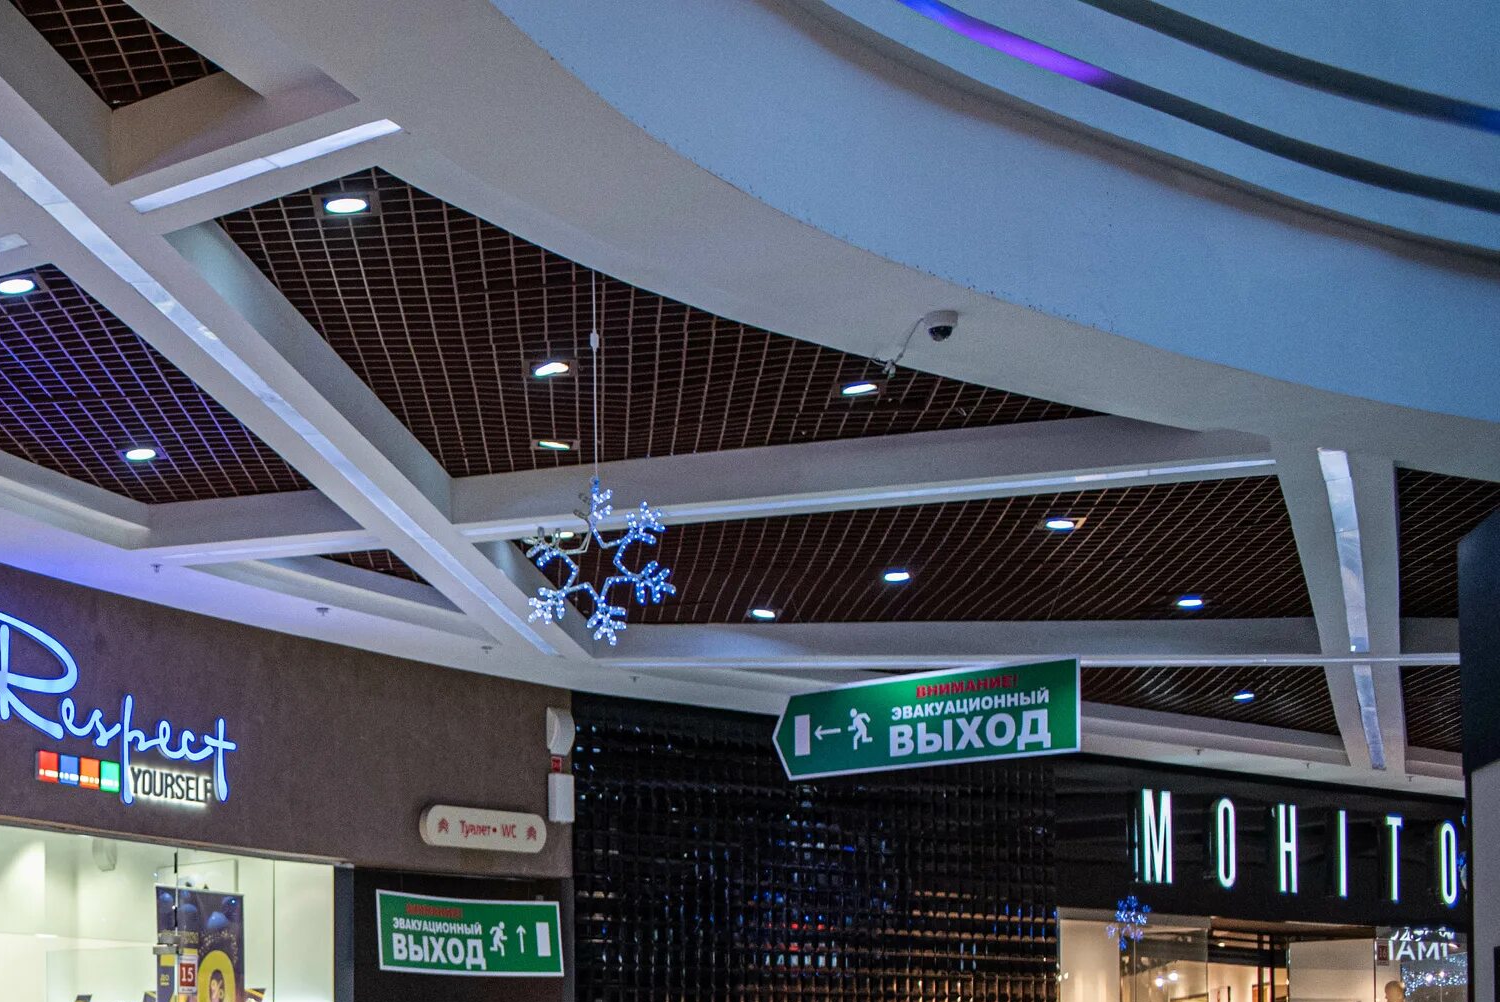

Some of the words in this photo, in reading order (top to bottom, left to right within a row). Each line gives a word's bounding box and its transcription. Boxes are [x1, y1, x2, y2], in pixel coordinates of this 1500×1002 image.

[916, 674, 1019, 699] ВНИМАНИЕ!
[891, 687, 1050, 720] ЭВАКУАЦИОННЫЙ
[889, 708, 1051, 757] ВЫХОД
[130, 765, 213, 800] YOURSELF
[501, 823, 517, 838] WC
[1142, 788, 1459, 905] MOHITO
[392, 917, 483, 935] ЭВАКУАЦИОННЫЙ
[392, 932, 487, 970] ВЫХОД
[181, 967, 195, 983] 15
